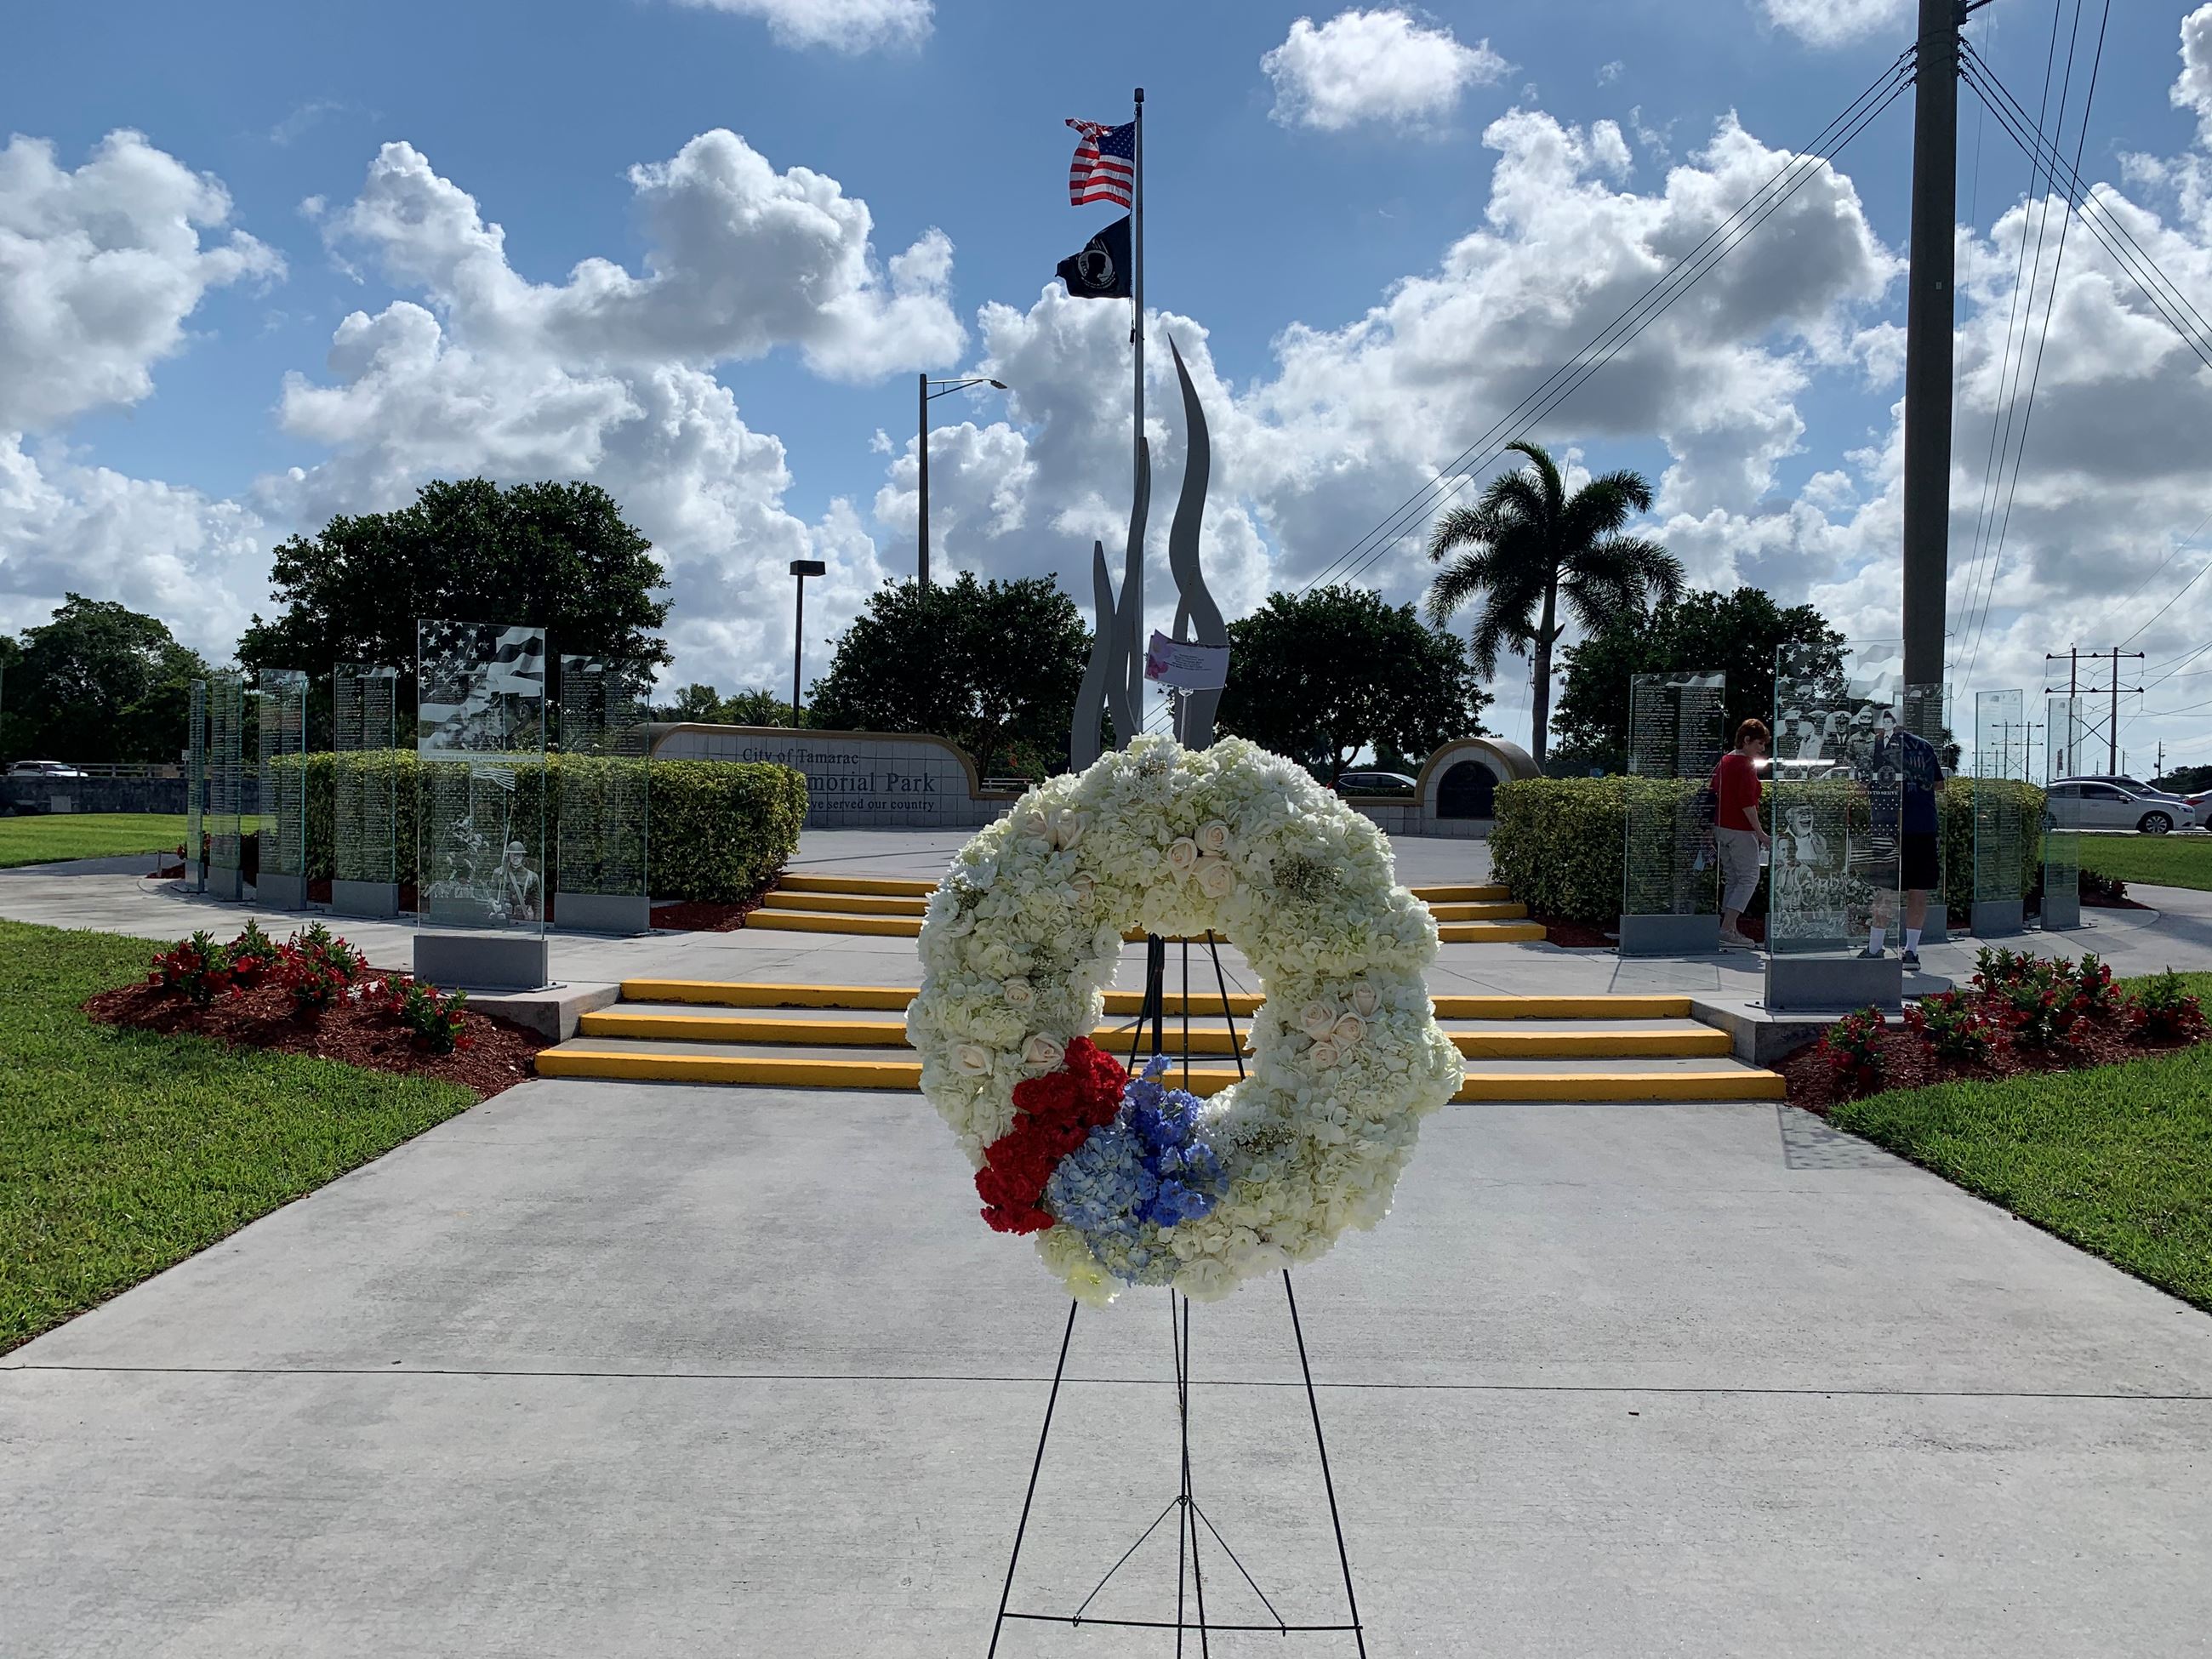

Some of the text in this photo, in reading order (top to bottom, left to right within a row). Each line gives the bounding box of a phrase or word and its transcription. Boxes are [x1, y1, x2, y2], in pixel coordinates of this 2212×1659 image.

[743, 747, 859, 764] City of Tamarac
[807, 772, 935, 792] morial Park
[827, 799, 864, 809] served
[868, 801, 887, 809] our
[891, 801, 935, 812] country
